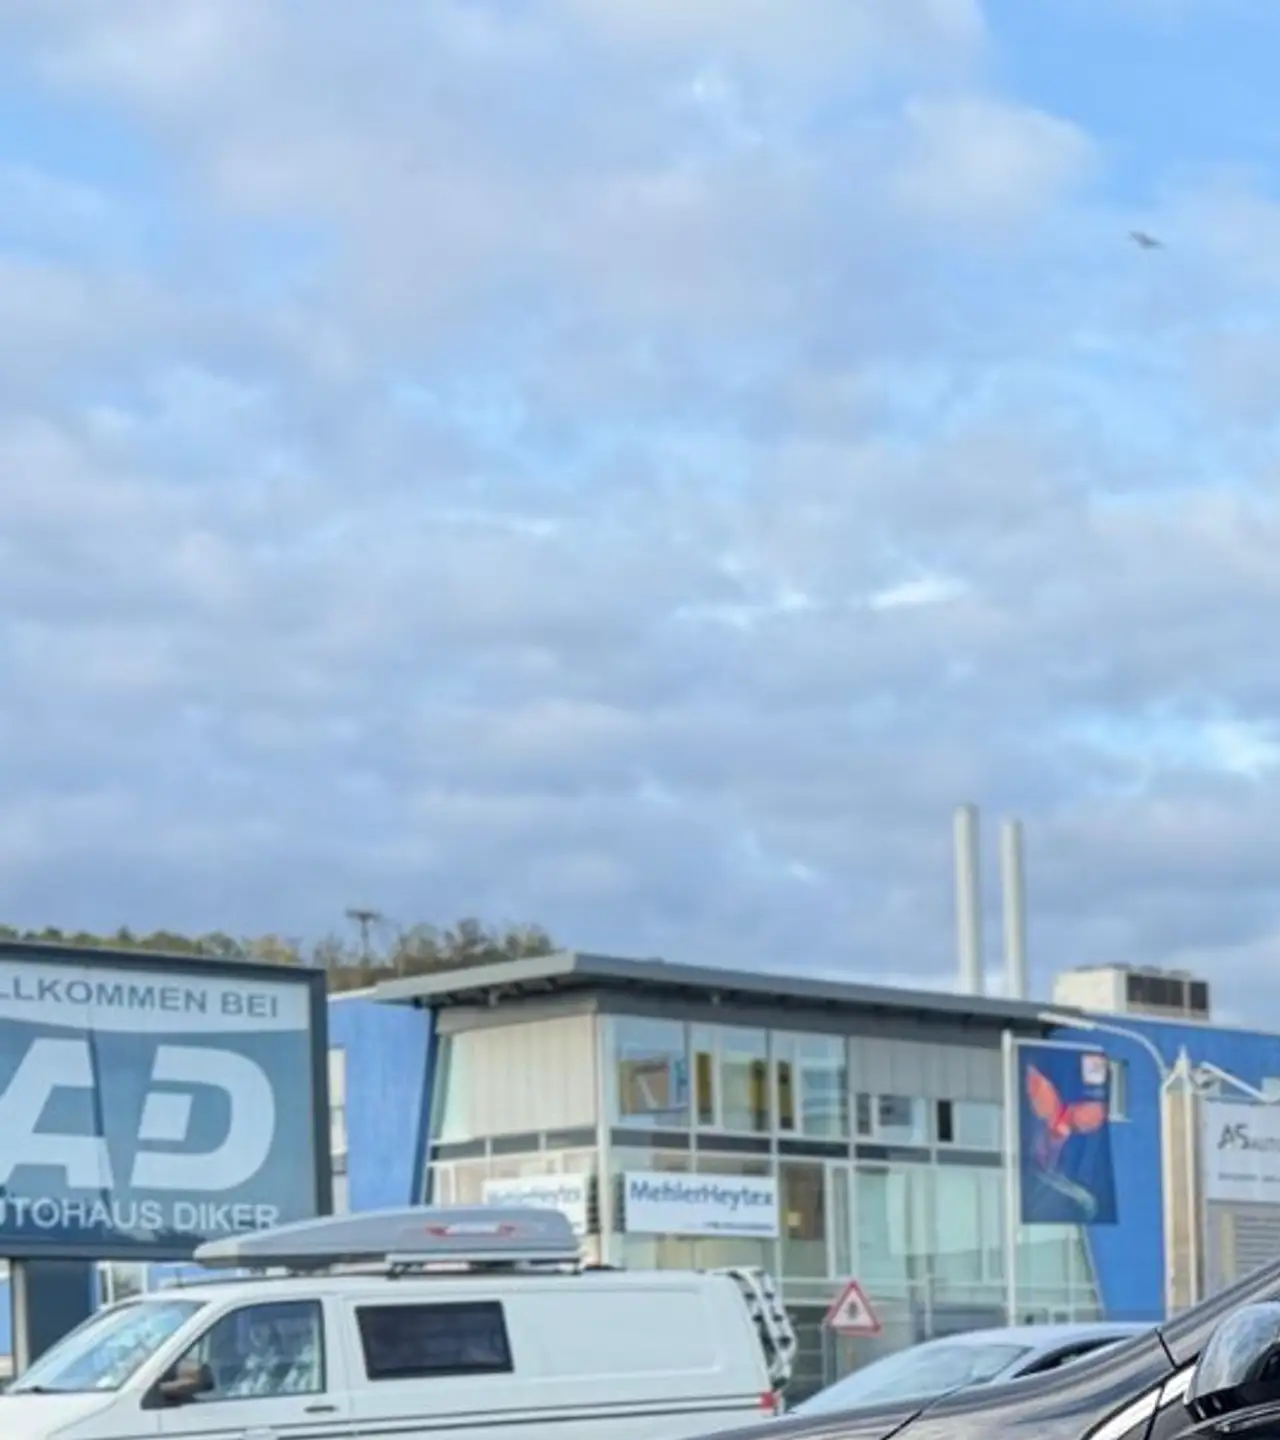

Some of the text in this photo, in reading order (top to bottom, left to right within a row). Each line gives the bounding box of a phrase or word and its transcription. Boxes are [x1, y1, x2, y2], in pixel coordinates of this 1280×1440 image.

[0, 974, 278, 1018] LKOMMEN BEI
[1217, 1123, 1249, 1150] AS
[173, 1200, 280, 1233] DIKER
